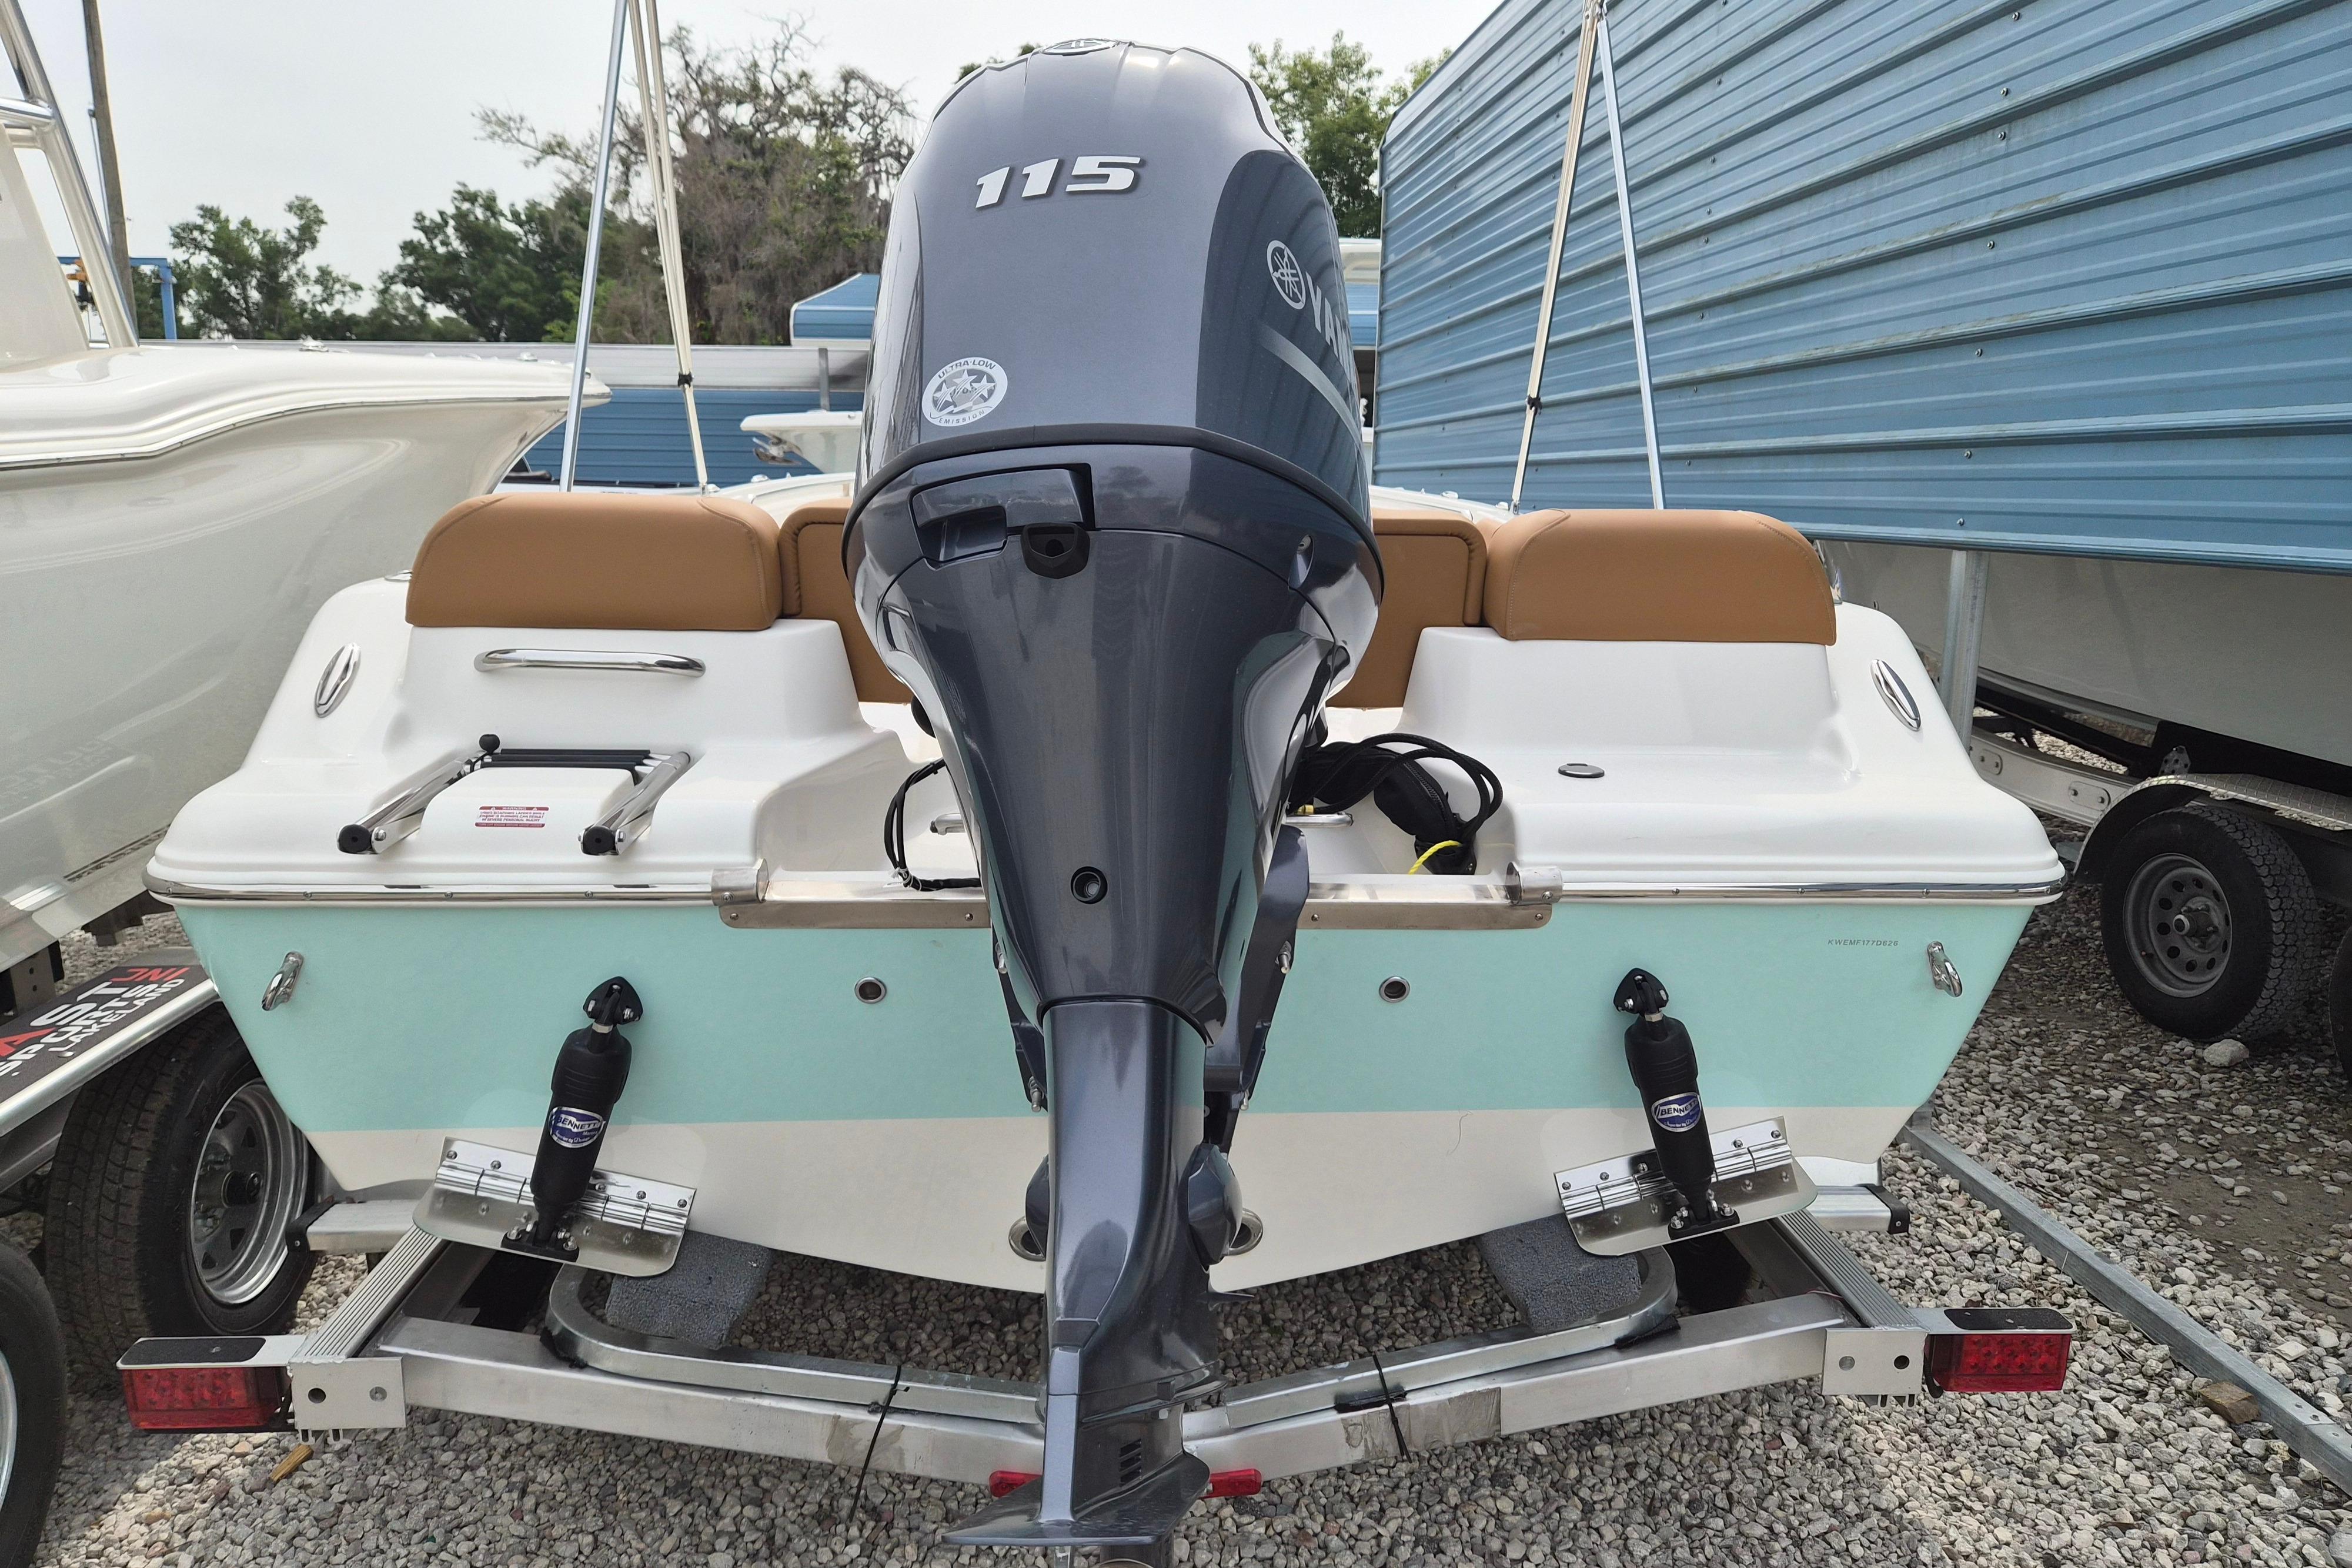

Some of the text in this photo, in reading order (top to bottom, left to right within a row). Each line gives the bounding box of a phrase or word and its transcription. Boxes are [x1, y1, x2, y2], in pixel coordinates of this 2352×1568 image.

[975, 155, 1141, 208] 115
[938, 410, 985, 424] EMISSION
[48, 978, 185, 1052] LAKELAND
